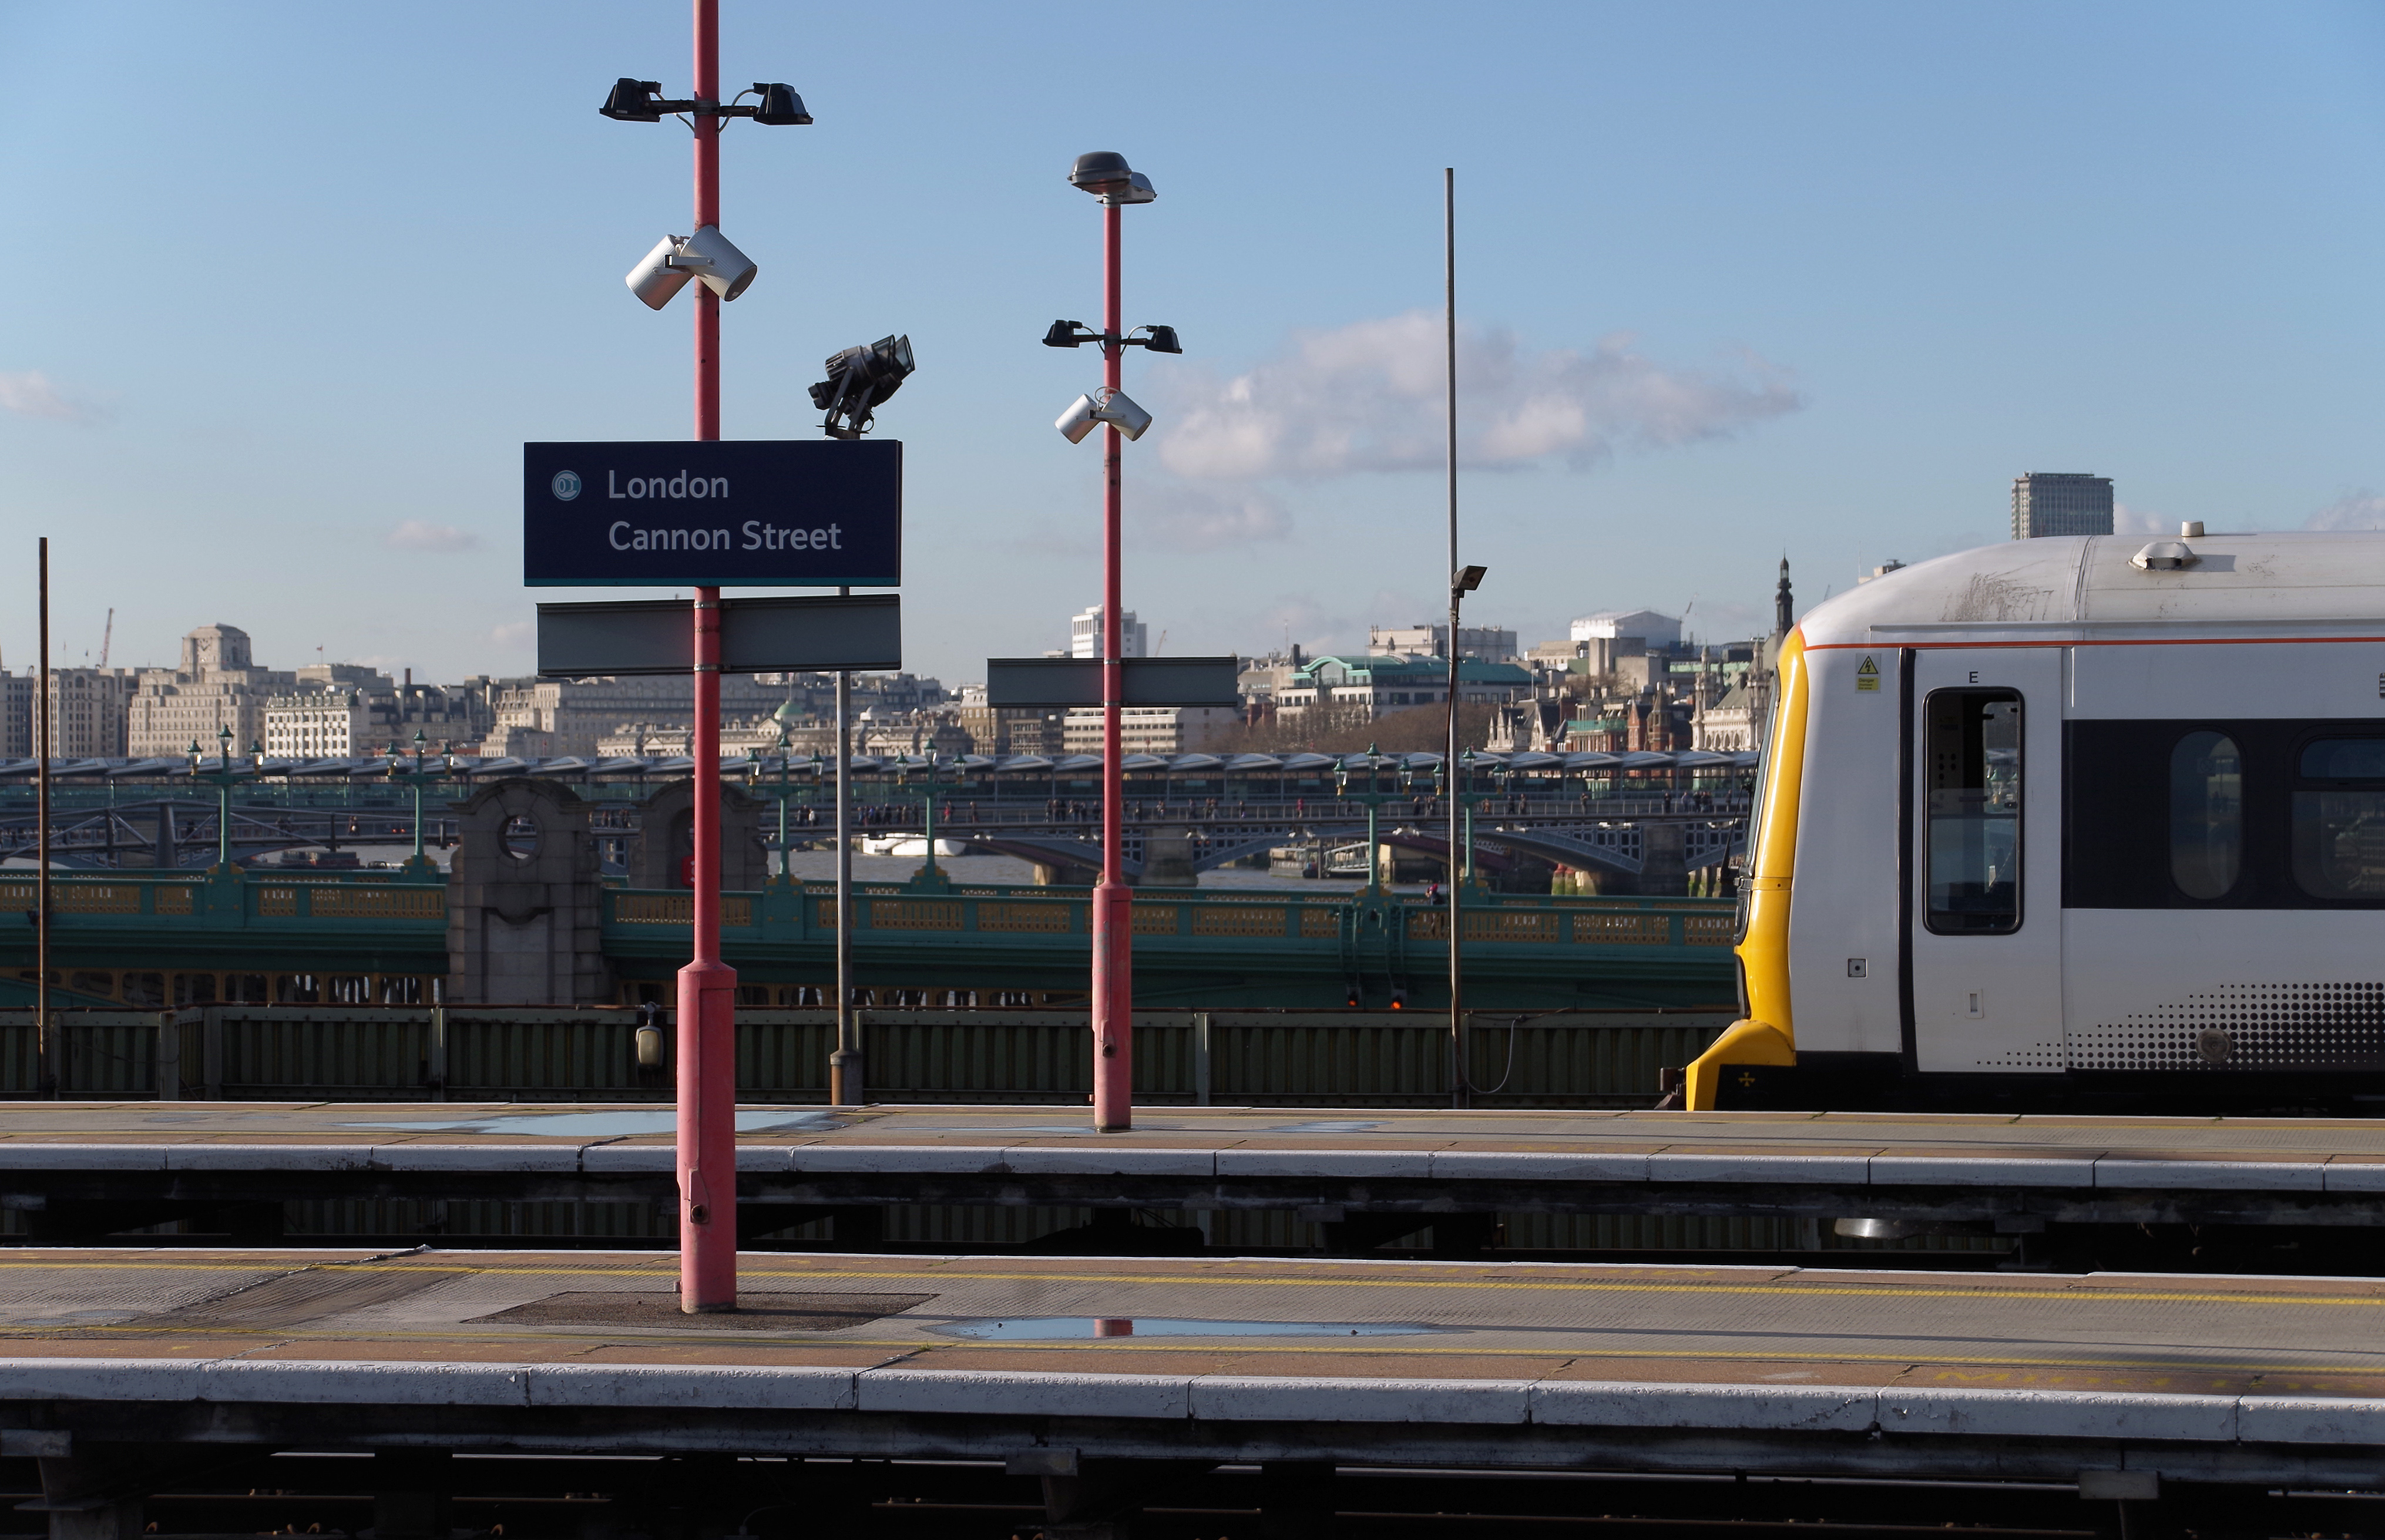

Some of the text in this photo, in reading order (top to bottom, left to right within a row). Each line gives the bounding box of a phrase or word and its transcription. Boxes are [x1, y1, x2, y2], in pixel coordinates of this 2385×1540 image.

[609, 469, 728, 499] London
[609, 520, 842, 550] Cannon Street
[1969, 671, 1978, 684] E
[1933, 1371, 2172, 1386] Mind
